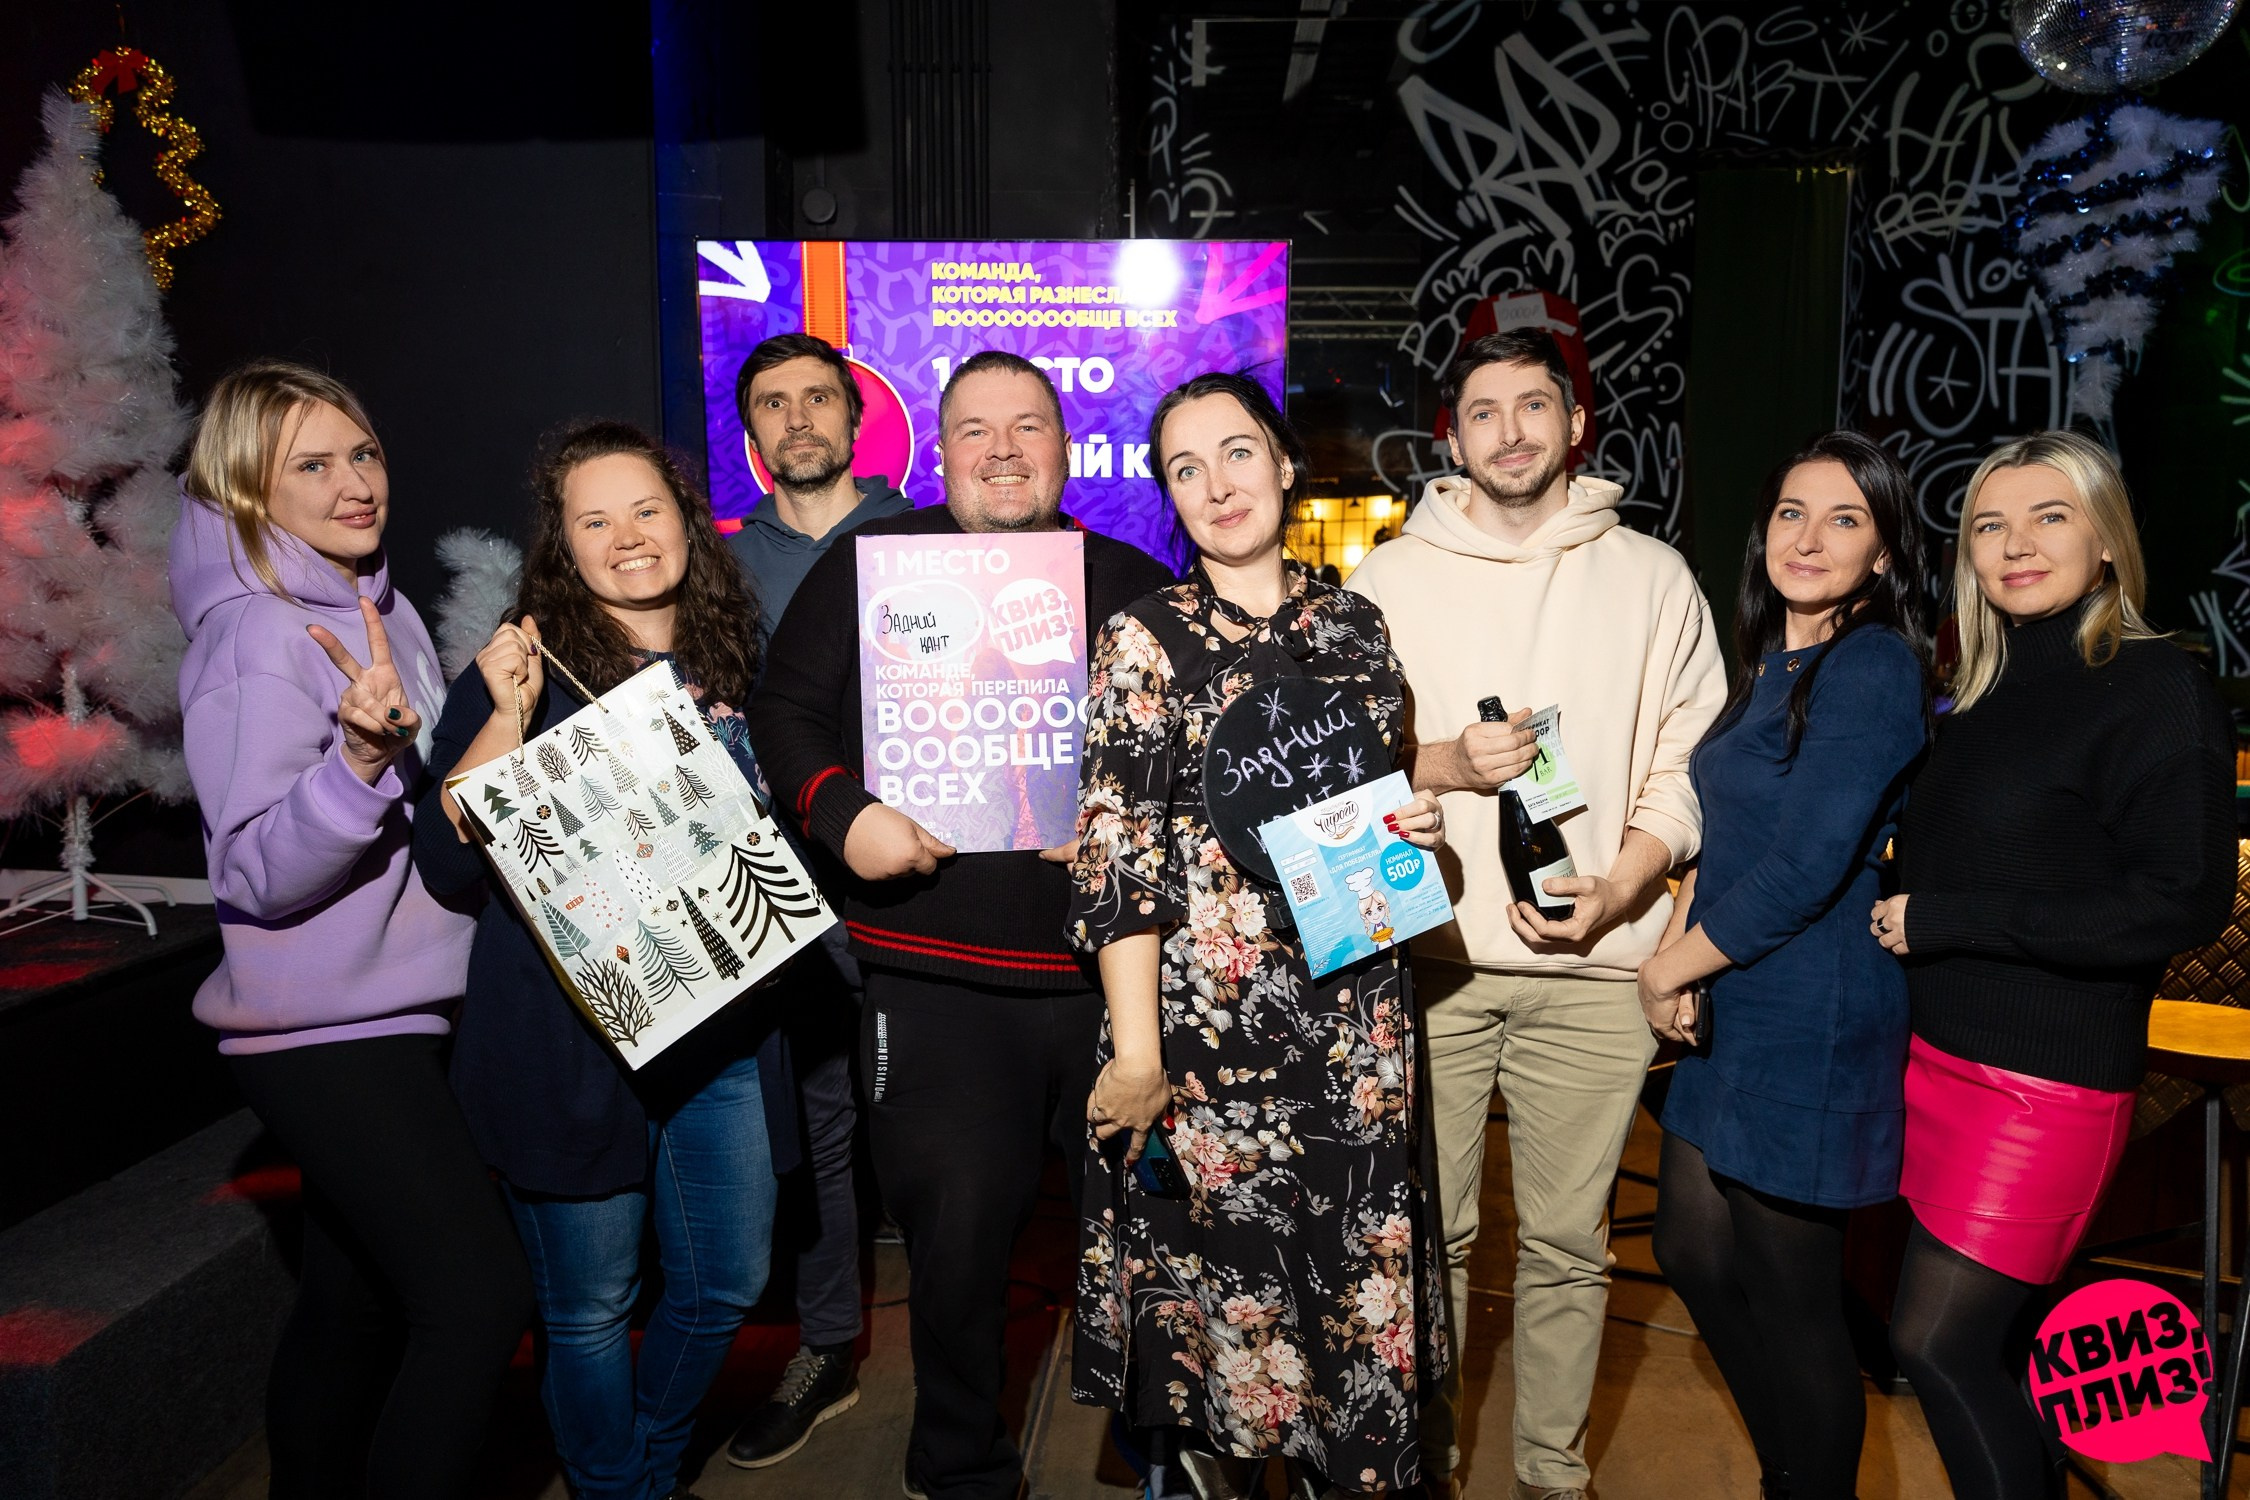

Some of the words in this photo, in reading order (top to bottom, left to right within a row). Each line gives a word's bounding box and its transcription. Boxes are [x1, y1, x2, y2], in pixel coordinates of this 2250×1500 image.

[931, 262, 1041, 283] КОМАНДА,
[931, 286, 1027, 304] КОТОРАЯ
[1124, 309, 1178, 327] ВСЕХ
[931, 356, 951, 392] 1
[873, 552, 886, 577] 1
[897, 548, 1010, 577] МЕСТО
[875, 662, 976, 682] КОМАНДЕ,
[875, 681, 965, 699] КОТОРАЯ
[971, 678, 1070, 697] ПЕРЕПИЛА
[877, 732, 1075, 771] ОООБЩЕ
[879, 772, 988, 807] ВСЕХ
[1385, 849, 1413, 865] НОМИНАЛ
[875, 1048, 888, 1091] DIVISION
